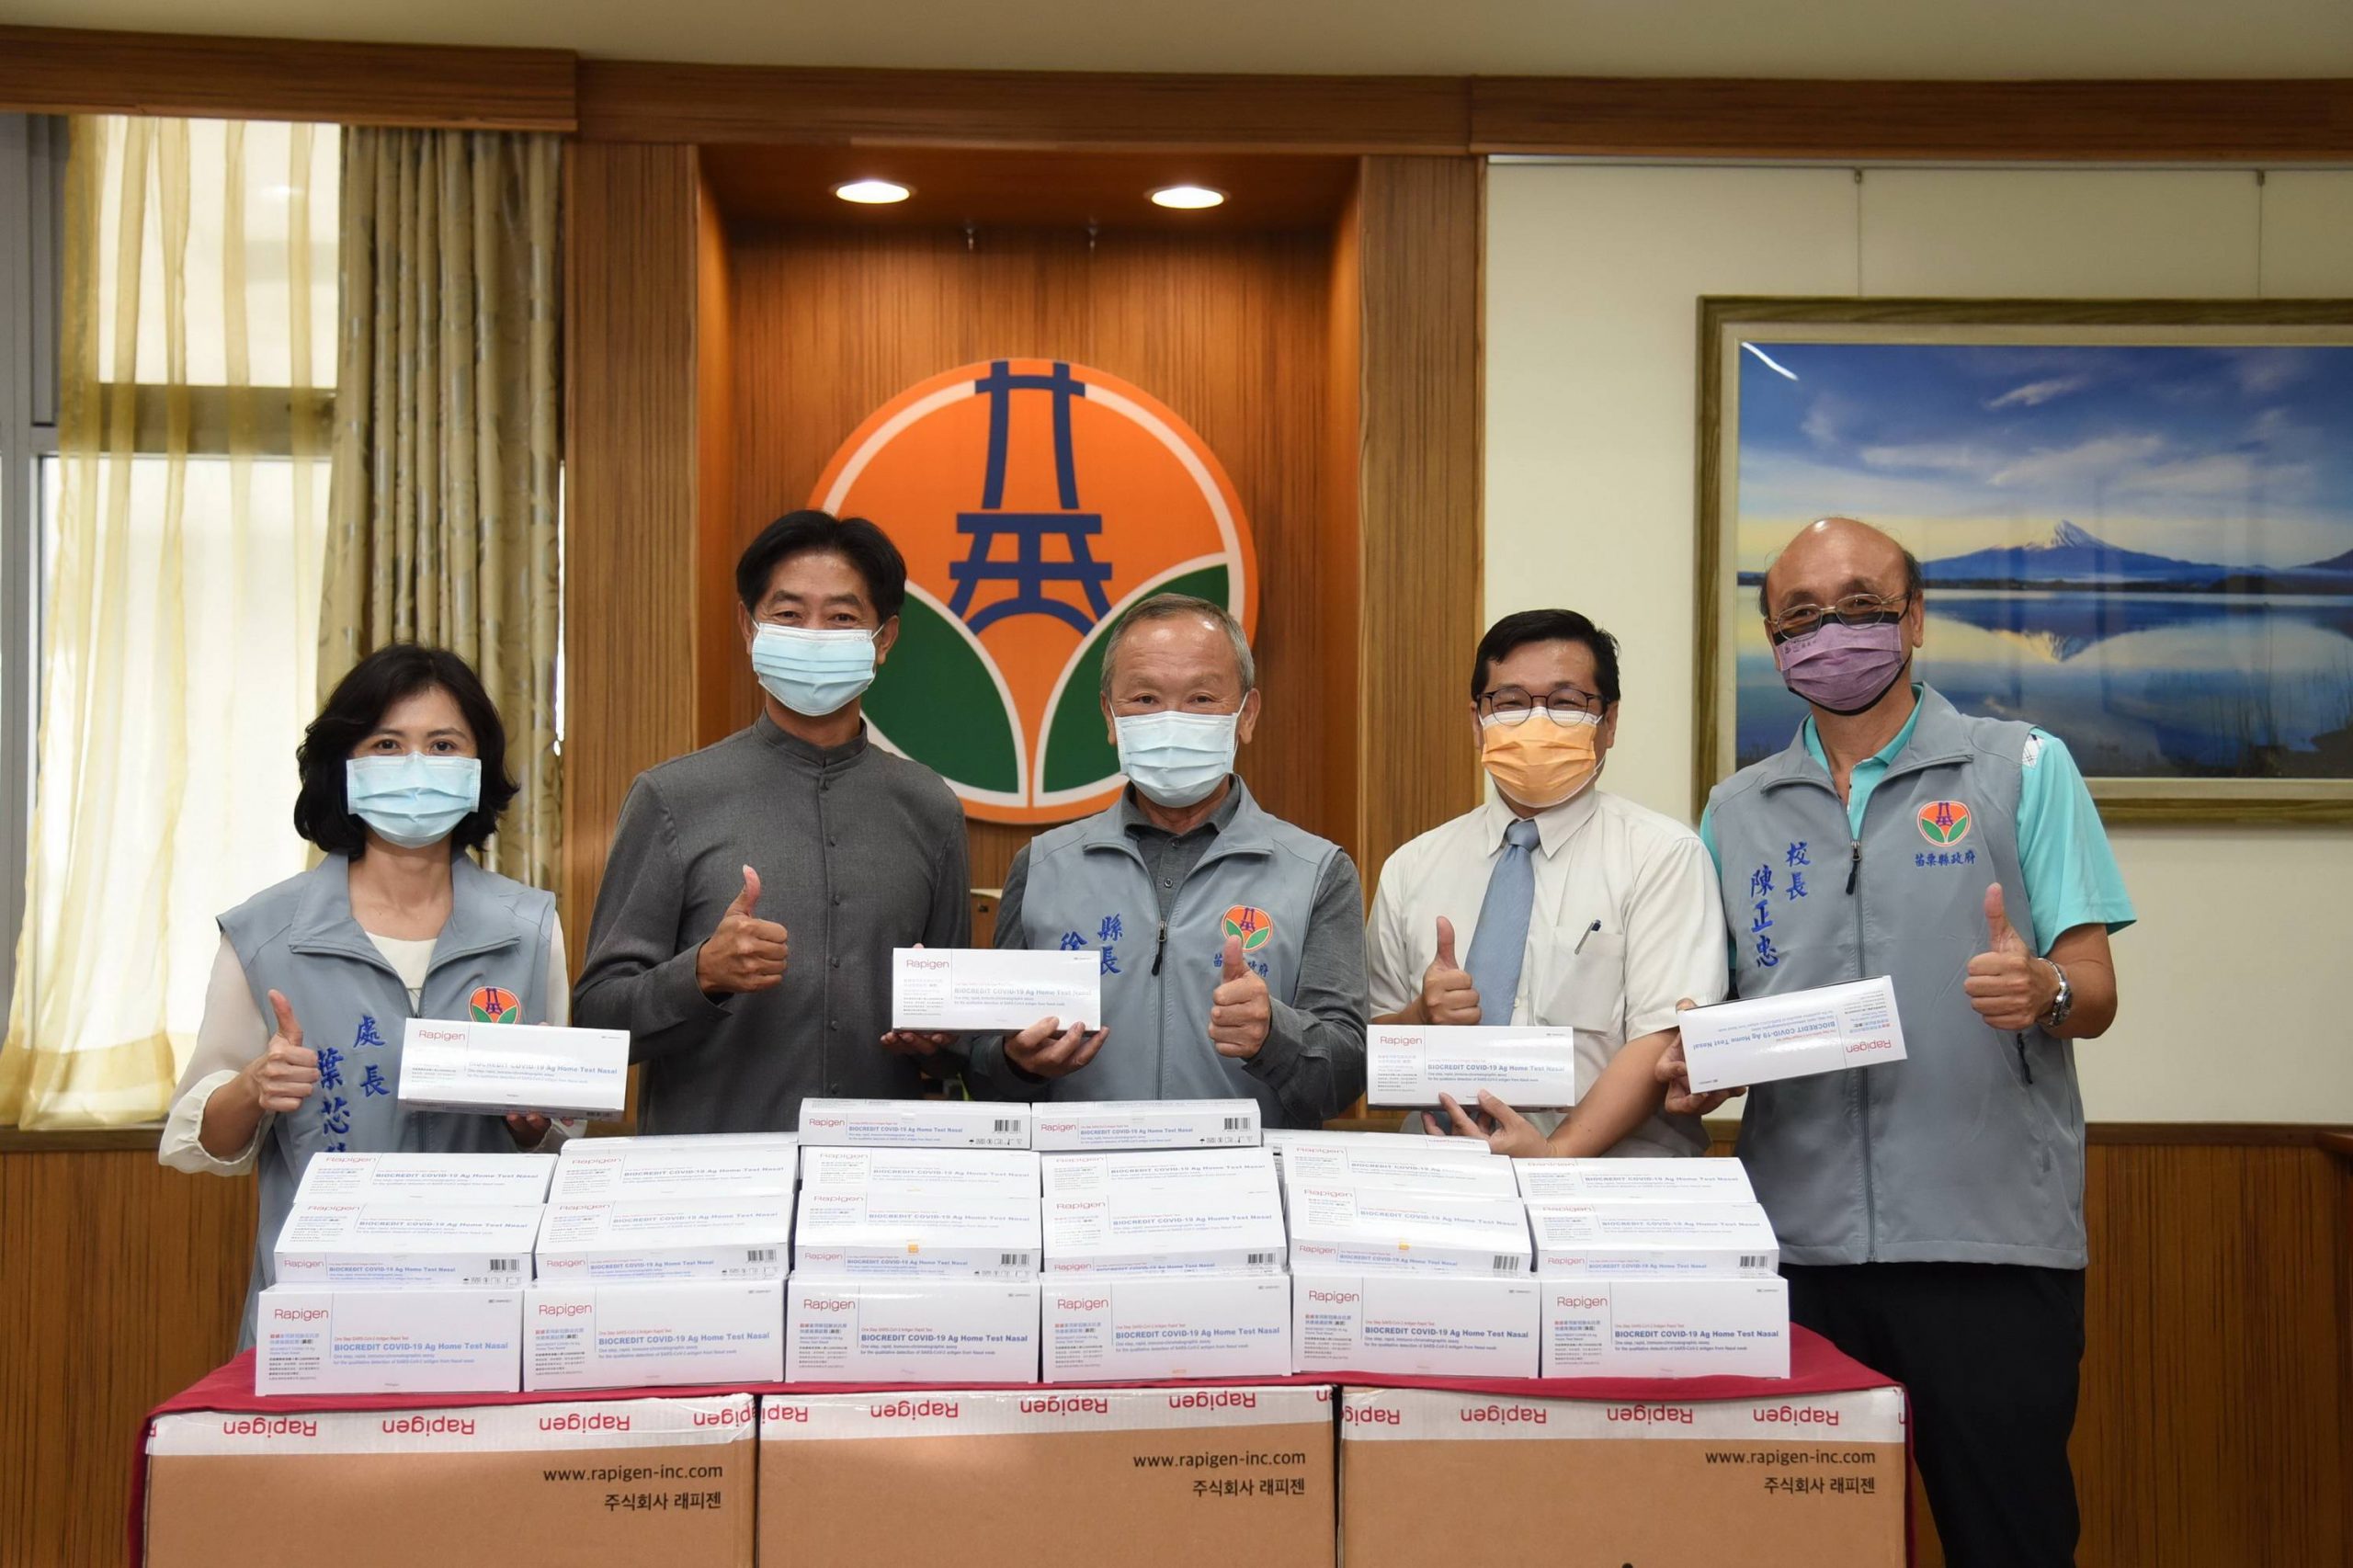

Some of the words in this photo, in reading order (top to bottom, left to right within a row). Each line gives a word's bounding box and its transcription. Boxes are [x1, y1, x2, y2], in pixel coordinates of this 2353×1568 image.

[1915, 849, 1976, 868] 苗栗縣政府
[1786, 842, 1812, 901] 校長
[1750, 865, 1780, 968] 陳正忠
[1097, 914, 1123, 975] 縣長
[906, 960, 949, 971] Rapigen
[1797, 1021, 1836, 1033] BIOCREDIT
[418, 1029, 465, 1041] Rapigen
[1731, 1035, 1751, 1043] Home
[1763, 1028, 1795, 1040] COVID-19
[1380, 1036, 1422, 1046] Rapigen
[1693, 1041, 1712, 1051] Nasal
[1714, 1038, 1730, 1046] Test
[1846, 1040, 1892, 1054] Rapigen
[353, 1015, 391, 1097] 處長
[318, 1046, 350, 1153] 葉芯
[809, 1119, 845, 1128] Rapigen
[908, 1126, 916, 1134] Ag
[1041, 1123, 1076, 1132] Rapigen
[804, 1252, 843, 1261] Rapigen
[1299, 1244, 1336, 1256] Rapigen
[284, 1259, 324, 1268] Rapigen
[547, 1259, 585, 1267] Rapigen
[1548, 1256, 1585, 1266] Rapigen
[1309, 1290, 1359, 1303] Rapigen
[1557, 1296, 1608, 1309] Rapigen
[539, 1303, 592, 1316] Rapigen
[803, 1299, 856, 1312] Rapigen
[1057, 1298, 1108, 1311] Rapigen
[275, 1309, 328, 1322] Rapigen
[860, 1334, 905, 1342] BIOCREDIT
[907, 1334, 947, 1342] COVID-19
[949, 1334, 959, 1343] Ag
[1115, 1330, 1160, 1339] BIOCREDIT
[1162, 1329, 1199, 1338] COVID-19
[1201, 1329, 1212, 1338] Ag
[1213, 1328, 1236, 1336] Home
[1238, 1327, 1256, 1335] Test
[1257, 1327, 1280, 1335] Nasal
[1365, 1326, 1409, 1335] BIOCREDIT
[1411, 1327, 1449, 1336] COVID-19
[1450, 1329, 1461, 1338] Ag
[1462, 1329, 1485, 1337] Home
[1487, 1330, 1505, 1338] Test
[1506, 1330, 1529, 1338] Nasal
[1615, 1330, 1659, 1338] BIOCREDIT
[1661, 1330, 1699, 1338] COVID-19
[1700, 1330, 1711, 1339] Ag
[1712, 1330, 1735, 1338] Home
[1737, 1330, 1755, 1338] Test
[598, 1335, 644, 1346] BIOCREDIT
[646, 1334, 686, 1344] COVID-19
[688, 1334, 699, 1344] Ag
[701, 1333, 725, 1342] Home
[727, 1333, 745, 1341] Test
[747, 1332, 770, 1340] Nasal
[334, 1342, 381, 1351] BIOCREDIT
[382, 1342, 423, 1351] COVID-19
[425, 1342, 437, 1352] Ag
[438, 1342, 462, 1350] Home
[464, 1342, 483, 1350] Test
[485, 1342, 508, 1350] Nasal
[762, 1404, 809, 1424] Rapi
[870, 1400, 960, 1421] Rapigen
[1020, 1396, 1108, 1416] Rapigen
[1169, 1391, 1256, 1411] Rapigen
[223, 1416, 318, 1437] Rapigen
[382, 1415, 475, 1437] Rapigen
[540, 1413, 631, 1434] Rapigen
[693, 1402, 756, 1427] pigen
[1340, 1405, 1400, 1426] Rapig
[1461, 1405, 1547, 1427] Rapigen
[1607, 1405, 1694, 1427] Rapigen
[1753, 1405, 1839, 1428] Rapigen
[1132, 1449, 1307, 1470] www.rapigen-inc.com
[1704, 1449, 1876, 1467] www.rapigen-inc.com
[543, 1462, 723, 1483] www.rapigen-inc.com
[1192, 1479, 1255, 1498] 주식회사
[1259, 1476, 1306, 1497] 래피젠
[1764, 1476, 1825, 1495] 주식회사
[1830, 1476, 1876, 1495] 래피젠
[604, 1492, 669, 1512] 주식회사
[674, 1490, 722, 1511] 래피젠
